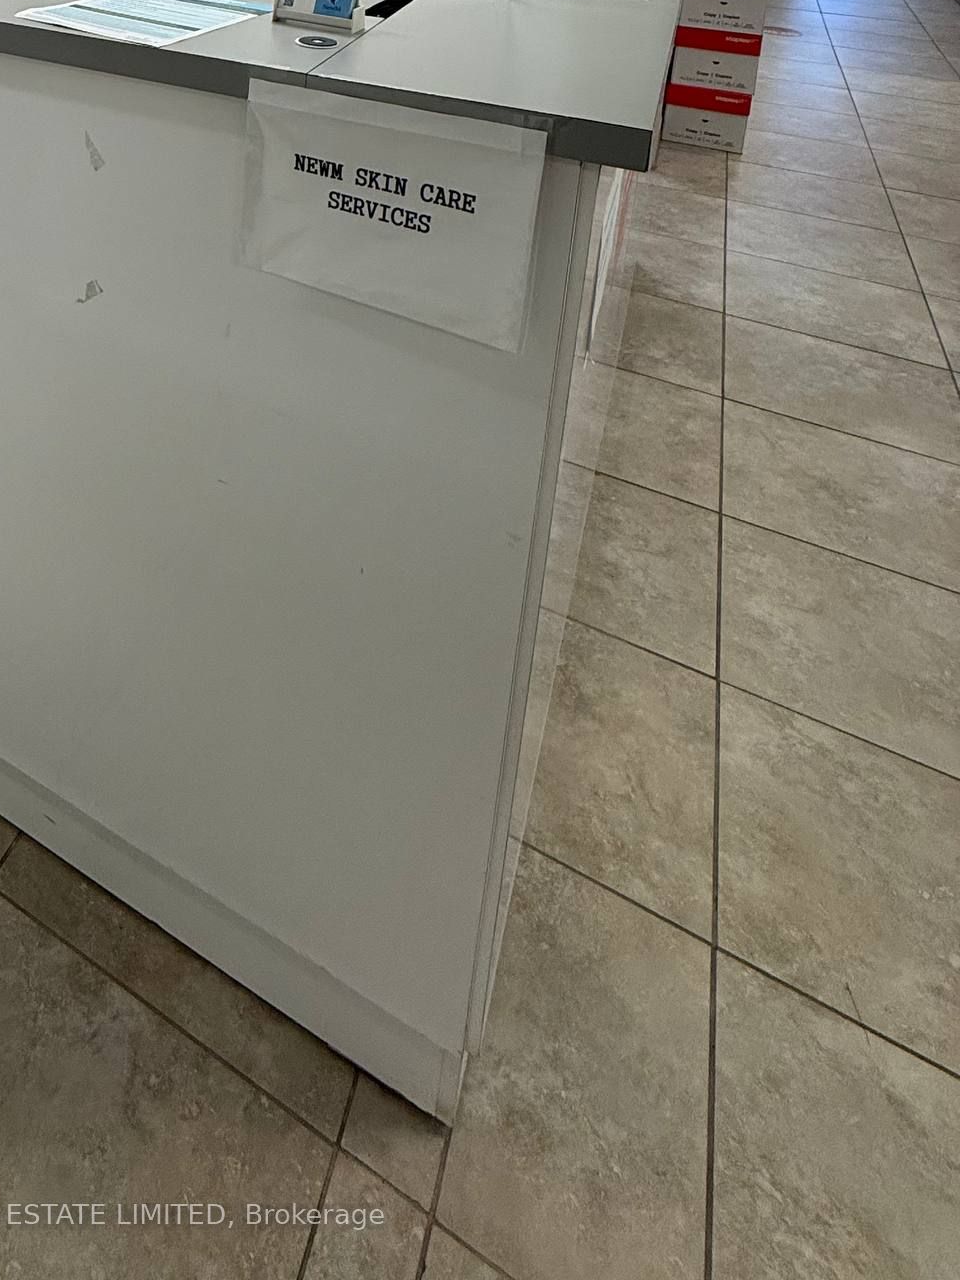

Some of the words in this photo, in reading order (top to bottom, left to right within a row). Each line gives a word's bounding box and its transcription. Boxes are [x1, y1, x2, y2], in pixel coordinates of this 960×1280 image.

[294, 154, 344, 181] NEWM
[355, 168, 408, 196] SKIN
[420, 183, 476, 213] CARE
[328, 191, 431, 233] SERVICES
